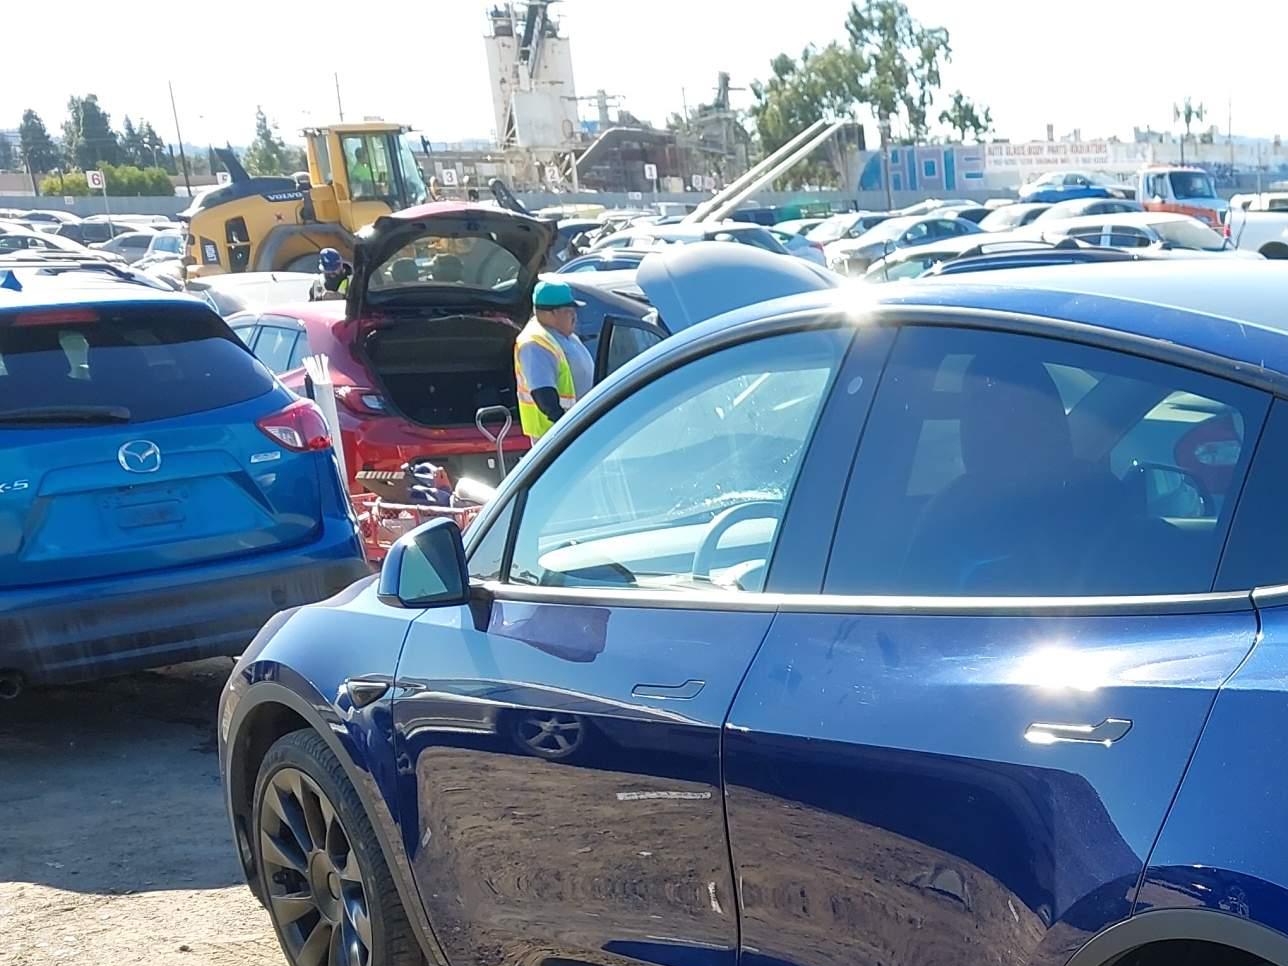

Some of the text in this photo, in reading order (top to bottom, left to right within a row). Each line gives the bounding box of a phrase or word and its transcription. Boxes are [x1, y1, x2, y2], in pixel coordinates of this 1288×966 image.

[91, 173, 101, 186] 6
[446, 171, 454, 183] 3
[267, 192, 303, 201] VOLVO
